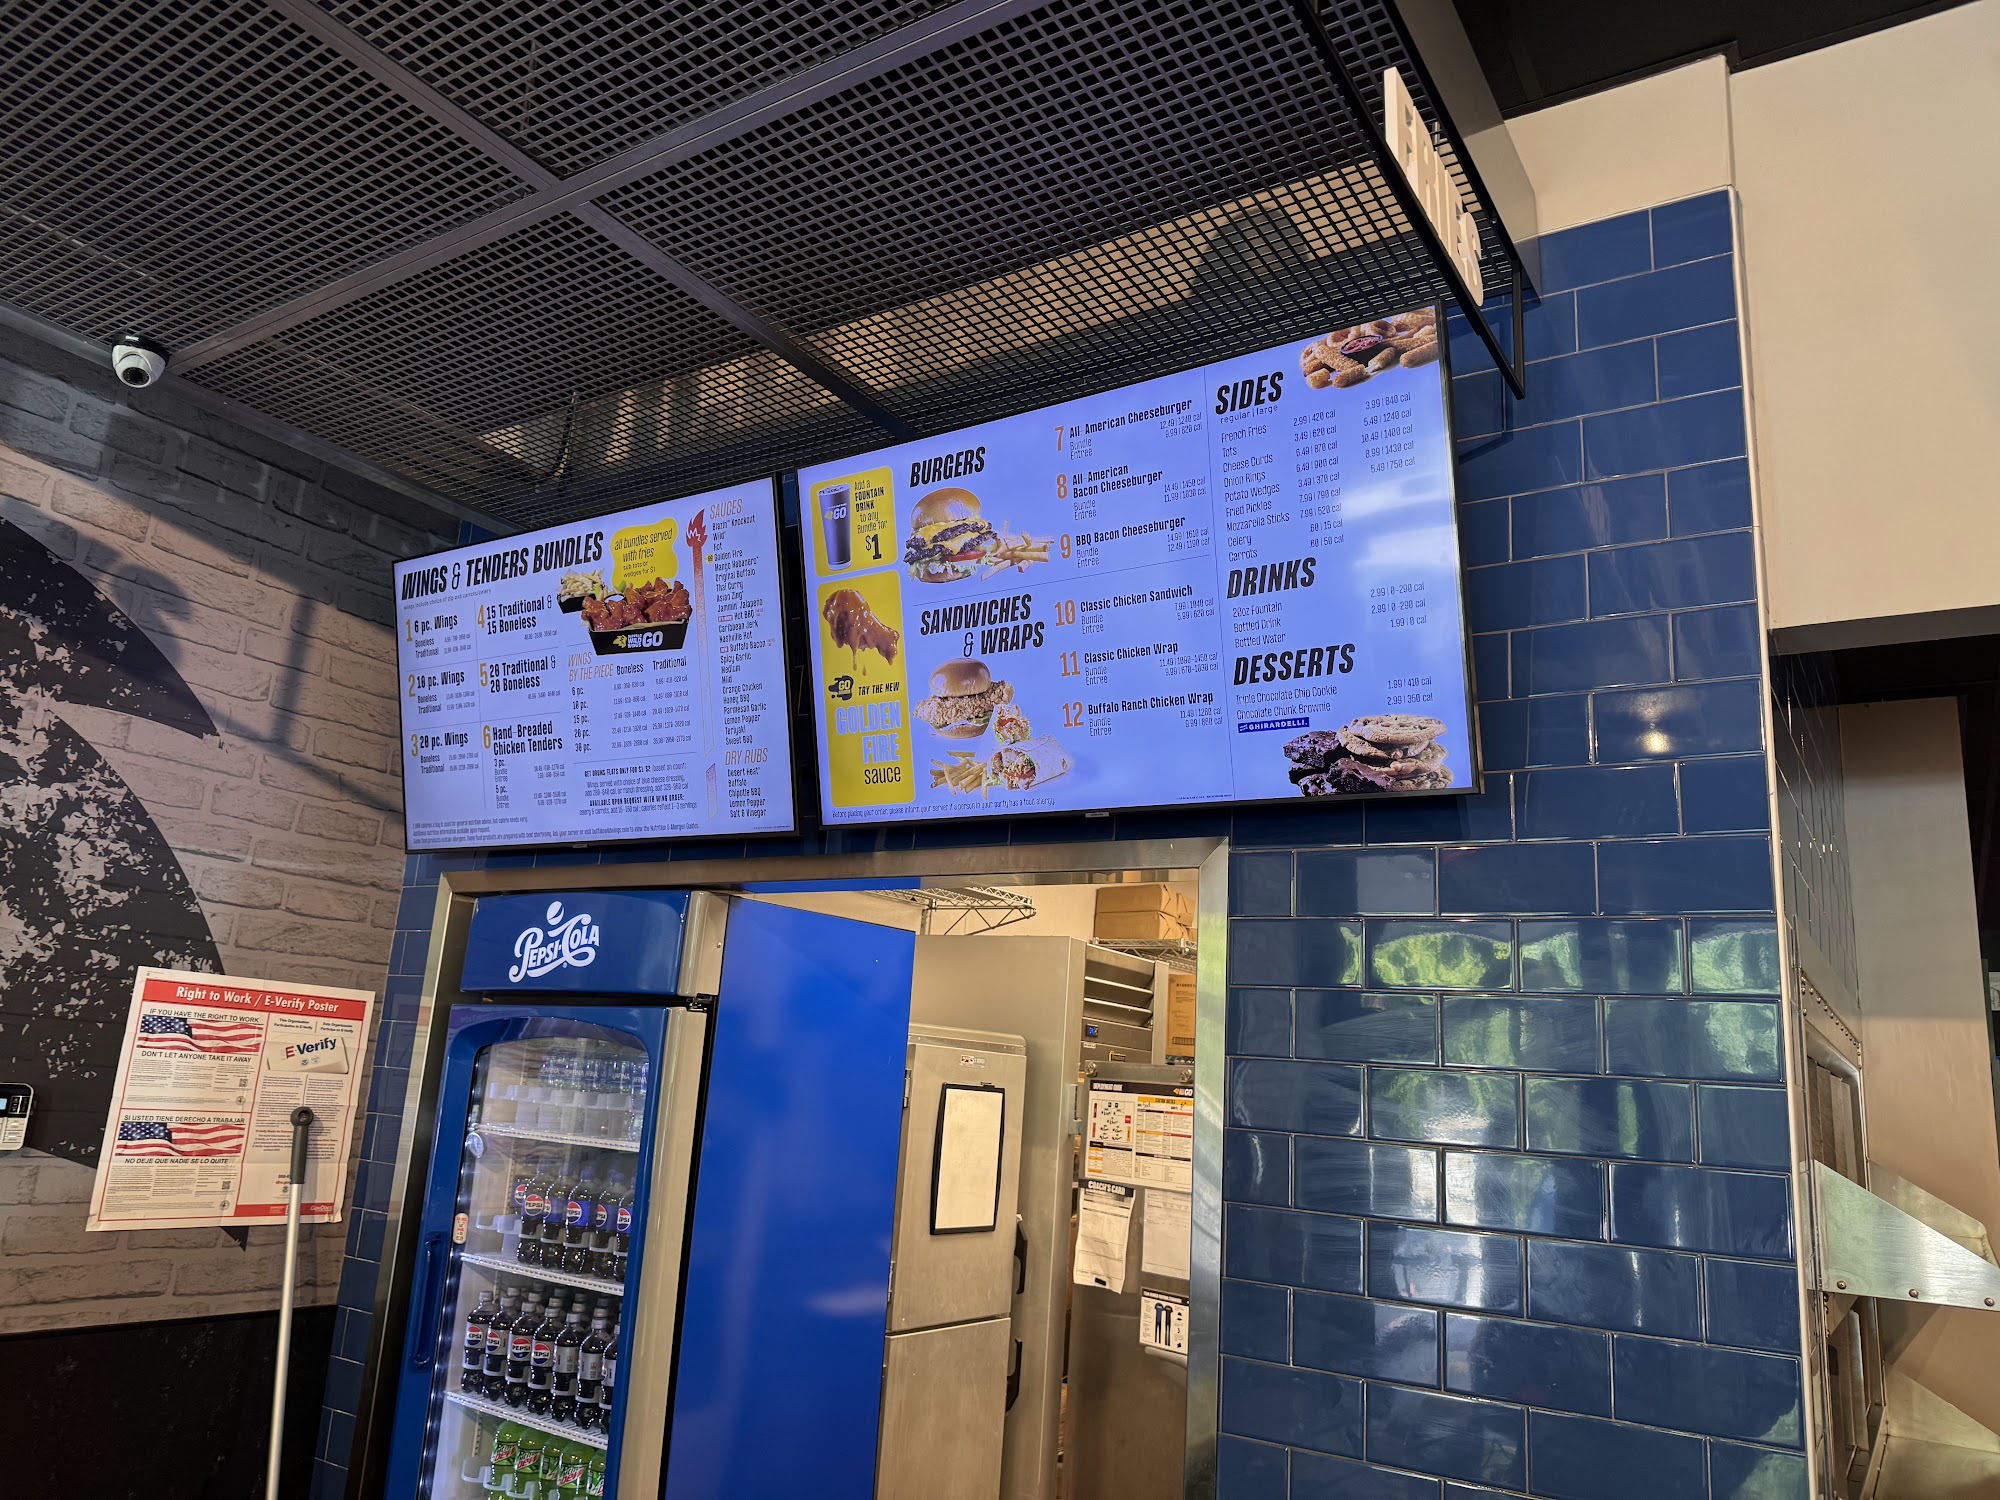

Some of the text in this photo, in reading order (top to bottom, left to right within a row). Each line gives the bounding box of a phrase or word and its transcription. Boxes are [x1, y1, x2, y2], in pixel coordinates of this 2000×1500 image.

[1215, 371, 1284, 416] SIDES
[1127, 399, 1192, 424] Cheeseburger
[1220, 404, 1278, 425] regular large
[1054, 425, 1065, 452] 7
[1069, 437, 1092, 451] Bundle
[1221, 424, 1267, 443] French Fries
[909, 446, 986, 488] BURGERS
[854, 486, 885, 502] FOUNTAIN
[1056, 473, 1068, 500] 8
[1073, 470, 1163, 499] Bacon Cheeseburger
[1224, 483, 1280, 503] Potato Wedges
[709, 498, 743, 520] SAUCES
[832, 505, 847, 520] GO
[855, 499, 875, 513] DRINK
[1075, 516, 1186, 547] BBQ Bacon Cheeseburger
[1226, 512, 1290, 532] Mozzarella Sticks
[614, 527, 673, 551] all bundles served
[865, 533, 882, 561] $1
[1059, 533, 1072, 560] 9
[622, 546, 655, 563] with fries
[401, 531, 604, 601] WINGS & TENDERS BUNDLES
[1226, 556, 1317, 599] DRINKS
[486, 605, 496, 620] 15
[498, 595, 545, 618] Traditional
[1080, 584, 1193, 613] Classic Chicken Sandwich
[477, 604, 486, 629] 4
[920, 593, 1032, 636] SANDWICHES
[1054, 599, 1076, 627] 10
[405, 618, 414, 643] 1
[414, 614, 458, 636] 6 pc. Wings
[487, 615, 537, 635] 15 Boneless
[641, 629, 664, 649] GO
[963, 621, 1045, 658] & WRAPS
[567, 651, 593, 668] WINGS
[652, 656, 687, 671] Traditional
[1059, 650, 1081, 677] 11
[1084, 642, 1179, 664] Classic Chicken Wrap
[479, 662, 489, 688] 5
[489, 663, 500, 679] 20
[501, 655, 549, 677] Traditional
[568, 663, 614, 683] BY THE PIECE
[616, 663, 644, 676] Boneless
[1233, 643, 1356, 686] DESSERTS
[407, 673, 417, 698] 2
[416, 670, 465, 691] 10 pc. Wings
[490, 675, 541, 694] 20 Boneless
[837, 679, 851, 691] GO
[858, 681, 900, 696] TRY THE NEW
[1062, 701, 1084, 728] 12
[1087, 692, 1214, 715] Buffalo Ranch Chicken Wrap
[835, 699, 902, 736] GOLDEN
[419, 731, 469, 751] 20 pc. Wings
[482, 724, 492, 750] 6
[492, 720, 553, 741] Hand-Breaded
[410, 733, 419, 758] 3
[493, 736, 563, 756] Chicken Tenders
[724, 747, 769, 766] DRY RUBS
[861, 732, 901, 765] FIRE
[864, 766, 901, 785] sauce
[175, 985, 207, 1002] Right
[208, 990, 221, 1001] to
[224, 990, 252, 1004] Work
[264, 994, 306, 1012] E-Verify
[307, 999, 339, 1012] Poster
[157, 1008, 173, 1016] YOU
[173, 1010, 193, 1018] HAVE
[193, 1011, 207, 1019] THE
[207, 1013, 229, 1021] RIGHT
[229, 1014, 239, 1022] TO
[238, 1015, 260, 1024] WORK
[141, 1050, 164, 1058] DON'T
[164, 1051, 178, 1059] LET
[177, 1052, 208, 1061] ANYONE
[208, 1054, 226, 1062] TAKE
[285, 1037, 337, 1059] E-Verify
[131, 1114, 155, 1122] USTED
[211, 1116, 246, 1125] TRABAJAR
[512, 1344, 531, 1352] PEPSI
